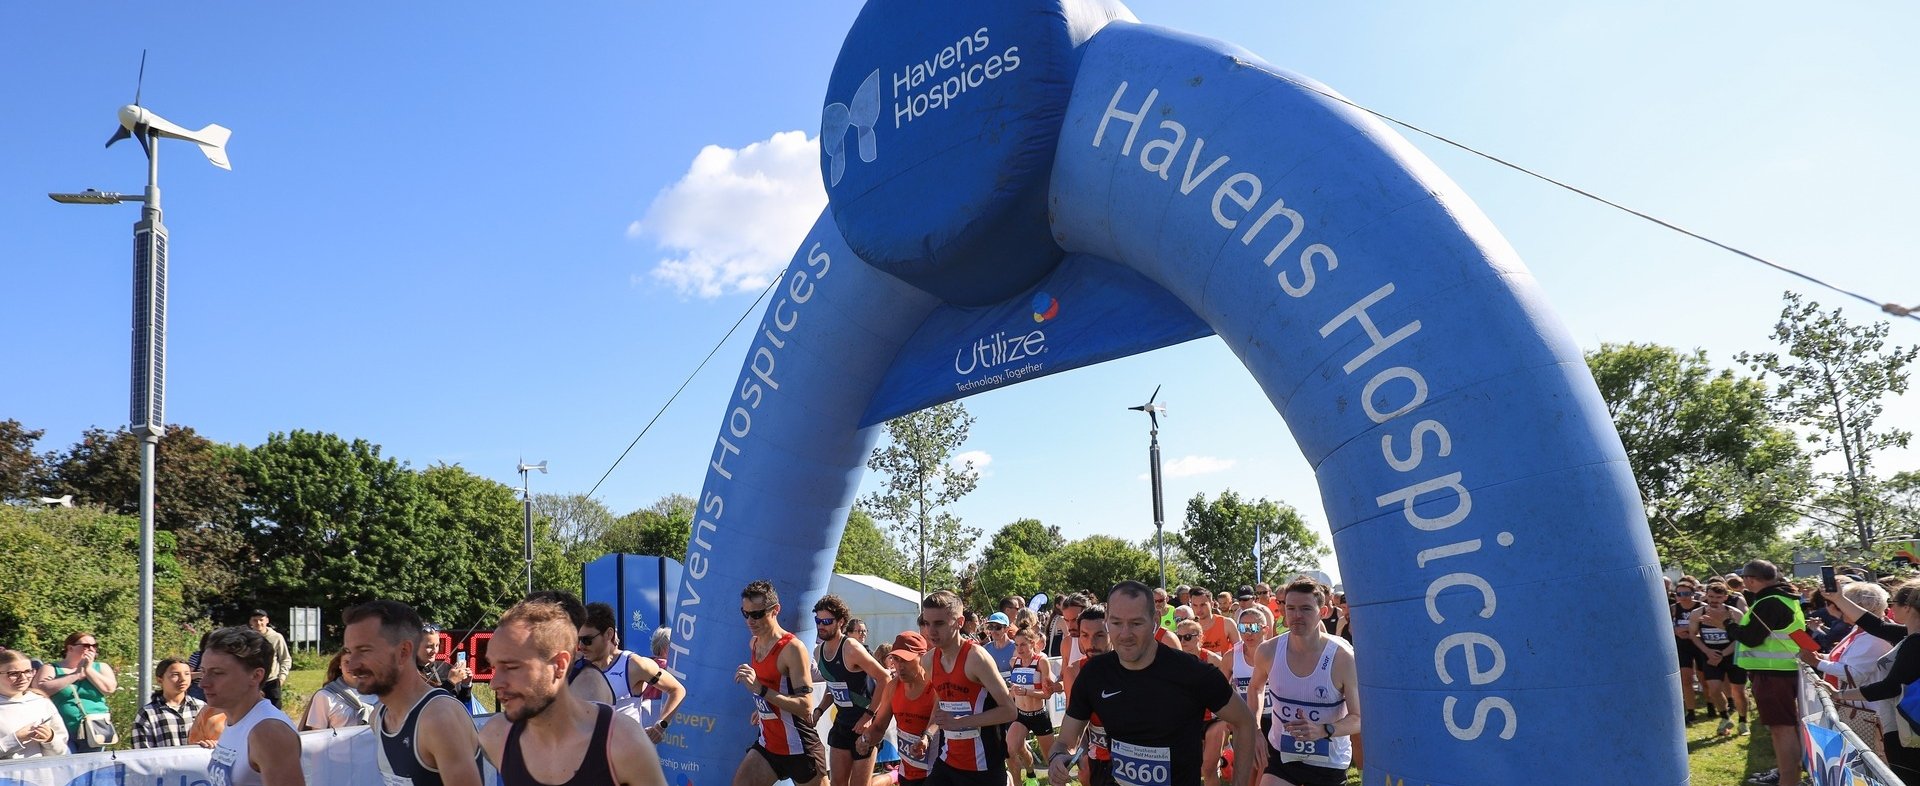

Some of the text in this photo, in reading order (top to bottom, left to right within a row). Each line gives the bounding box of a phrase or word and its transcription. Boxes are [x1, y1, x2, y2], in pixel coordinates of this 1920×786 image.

[893, 26, 990, 98] Havens
[894, 45, 1021, 129] Hospices
[955, 330, 1045, 375] Utilize
[956, 362, 1043, 392] Technology. Together
[1092, 80, 1518, 742] Havens Hospices
[667, 241, 832, 681] Havens Hospices
[1322, 656, 1330, 670] soar
[1016, 674, 1027, 684] 86
[675, 712, 716, 733] every
[1282, 706, 1291, 717] C
[1309, 710, 1320, 722] C
[1294, 740, 1316, 755] 93
[680, 759, 700, 772] with
[1113, 757, 1168, 783] 2660
